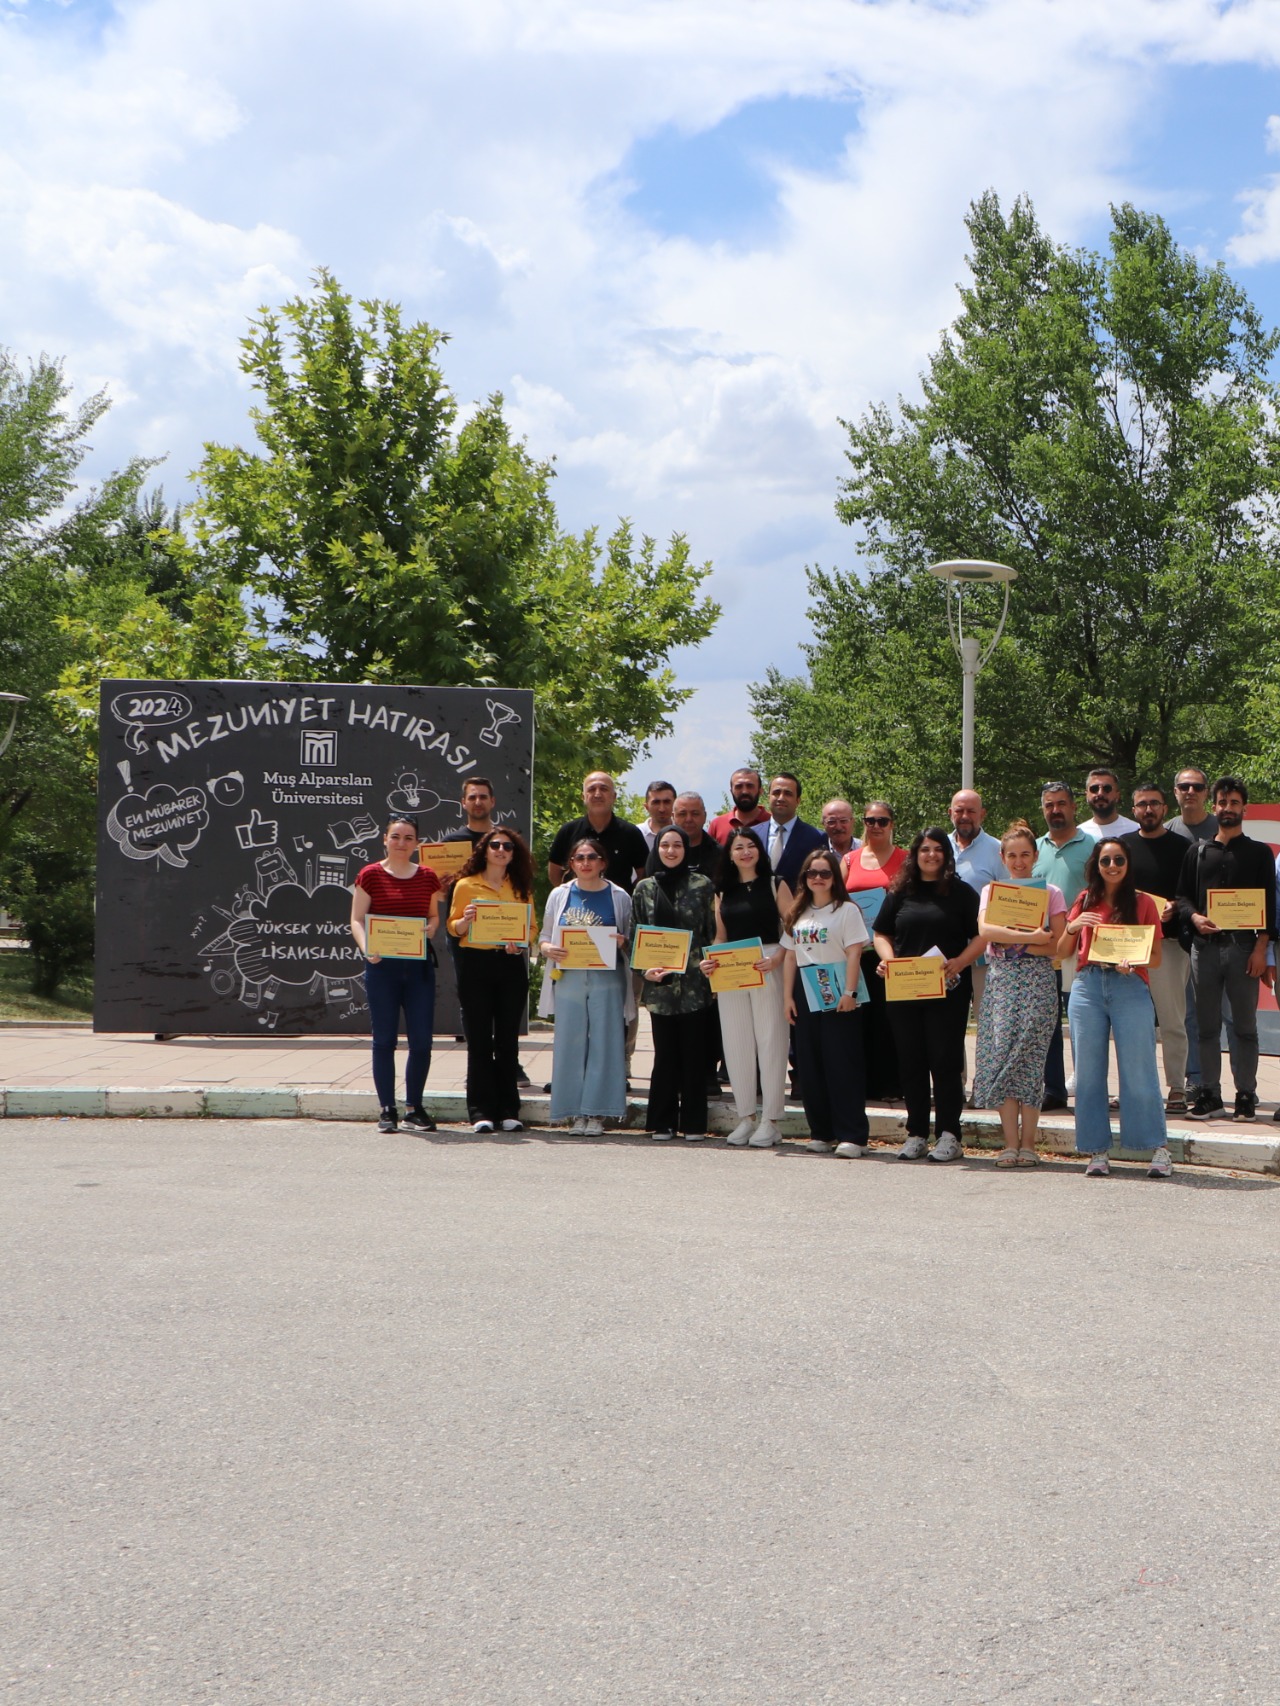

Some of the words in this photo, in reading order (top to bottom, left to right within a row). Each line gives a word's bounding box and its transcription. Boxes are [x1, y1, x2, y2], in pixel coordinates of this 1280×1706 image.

[128, 696, 183, 718] 2024
[157, 697, 336, 763] MEZUNİYET
[348, 699, 477, 773] HATIRASI
[263, 772, 296, 788] Muş
[299, 772, 373, 788] Alparslan
[272, 788, 364, 805] Üniversitesi
[125, 814, 143, 828] EN
[146, 795, 202, 821] MÜBAREK
[132, 810, 202, 842] MEZUNİYET
[256, 920, 311, 935] YÜKSEK
[316, 921, 353, 935] YÜKS
[261, 941, 366, 960] LİSANSLARA
